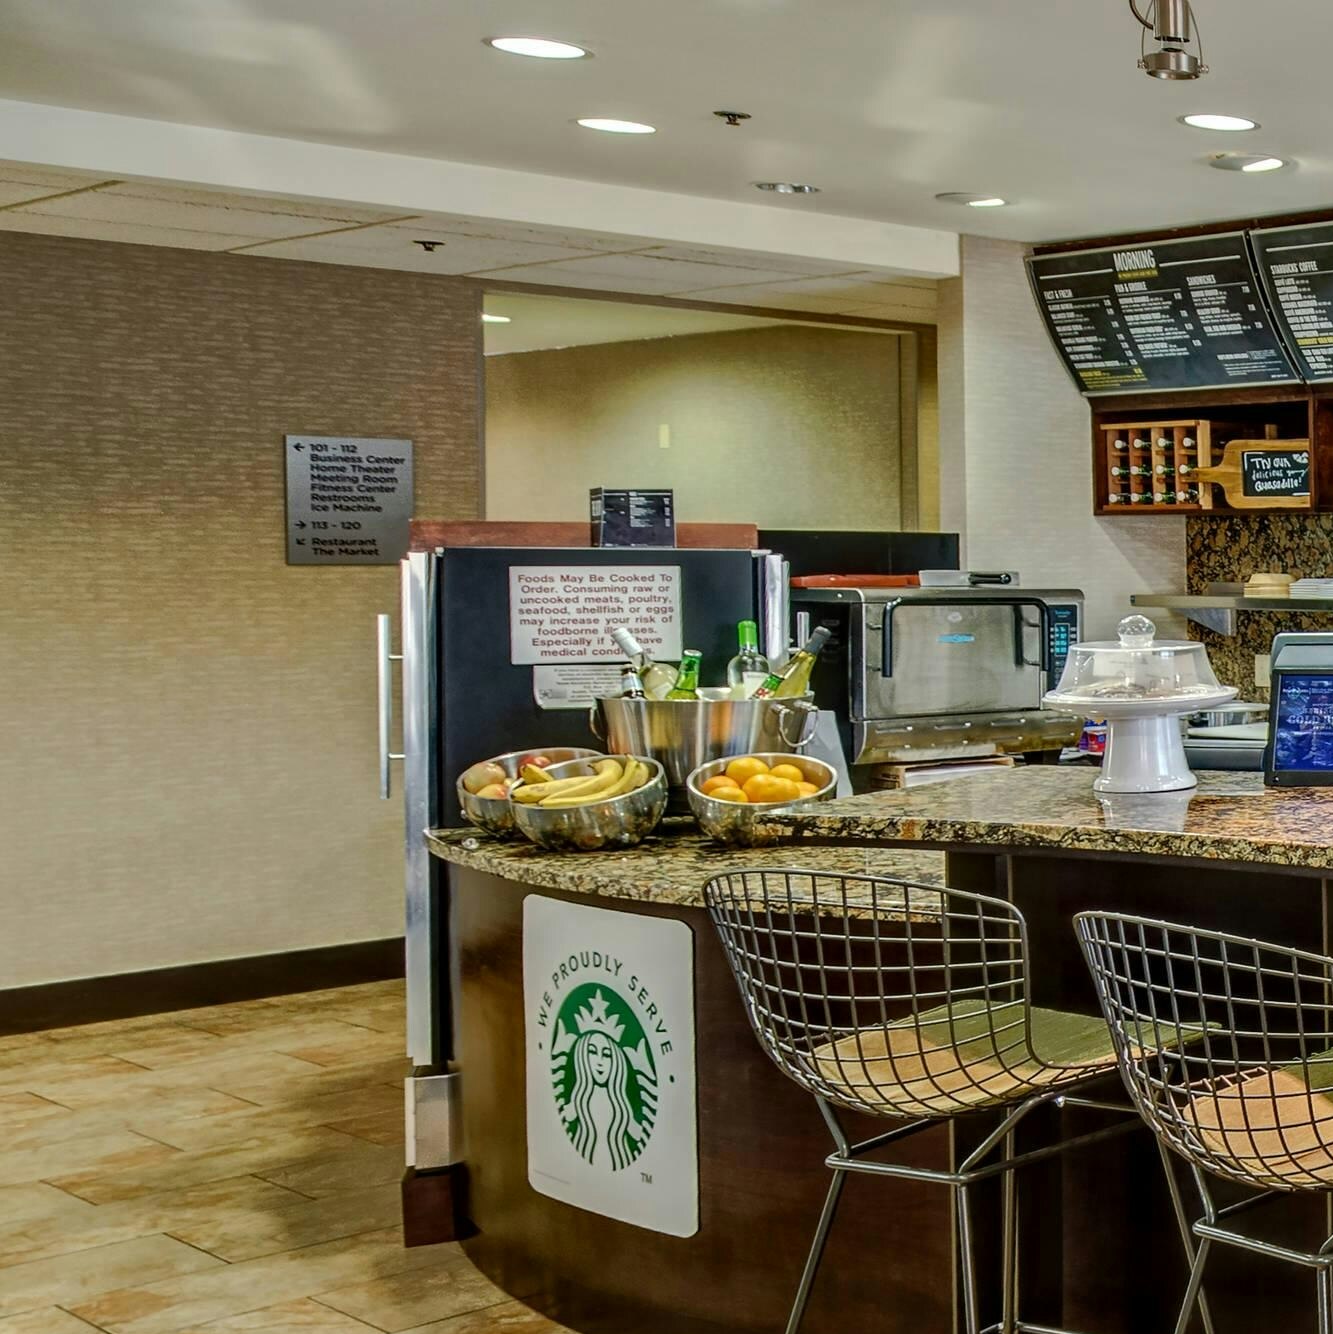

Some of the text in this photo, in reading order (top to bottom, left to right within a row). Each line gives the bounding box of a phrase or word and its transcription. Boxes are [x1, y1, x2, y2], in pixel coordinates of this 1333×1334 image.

[1113, 249, 1156, 272] MORNING
[309, 443, 329, 452] 101
[340, 444, 358, 453] 112
[310, 453, 405, 465] Business Center
[310, 464, 396, 474] Home Theater
[310, 474, 399, 484] Meeting Room
[310, 483, 396, 493] Fitness Center
[310, 493, 376, 503] Restrooms
[311, 504, 383, 513] Ice Machine
[311, 521, 329, 530] 113
[341, 521, 362, 530] 120
[311, 537, 377, 546] Restaurant
[312, 547, 380, 556] The Market
[517, 574, 673, 584] Foods May Be Cooked To
[521, 585, 558, 594] Order.
[563, 585, 628, 595] Consuming
[520, 595, 673, 605] uncooked meats, poultry,
[518, 606, 571, 616] seafood,
[575, 606, 624, 614] shellfish
[646, 606, 674, 615] eggs
[519, 615, 673, 627] may increase your risk of
[537, 627, 599, 635] foodborne
[532, 638, 592, 647] Especially
[597, 638, 605, 646] if
[540, 648, 587, 657] medical
[537, 951, 673, 1056] WE PROUDLY SERVE
